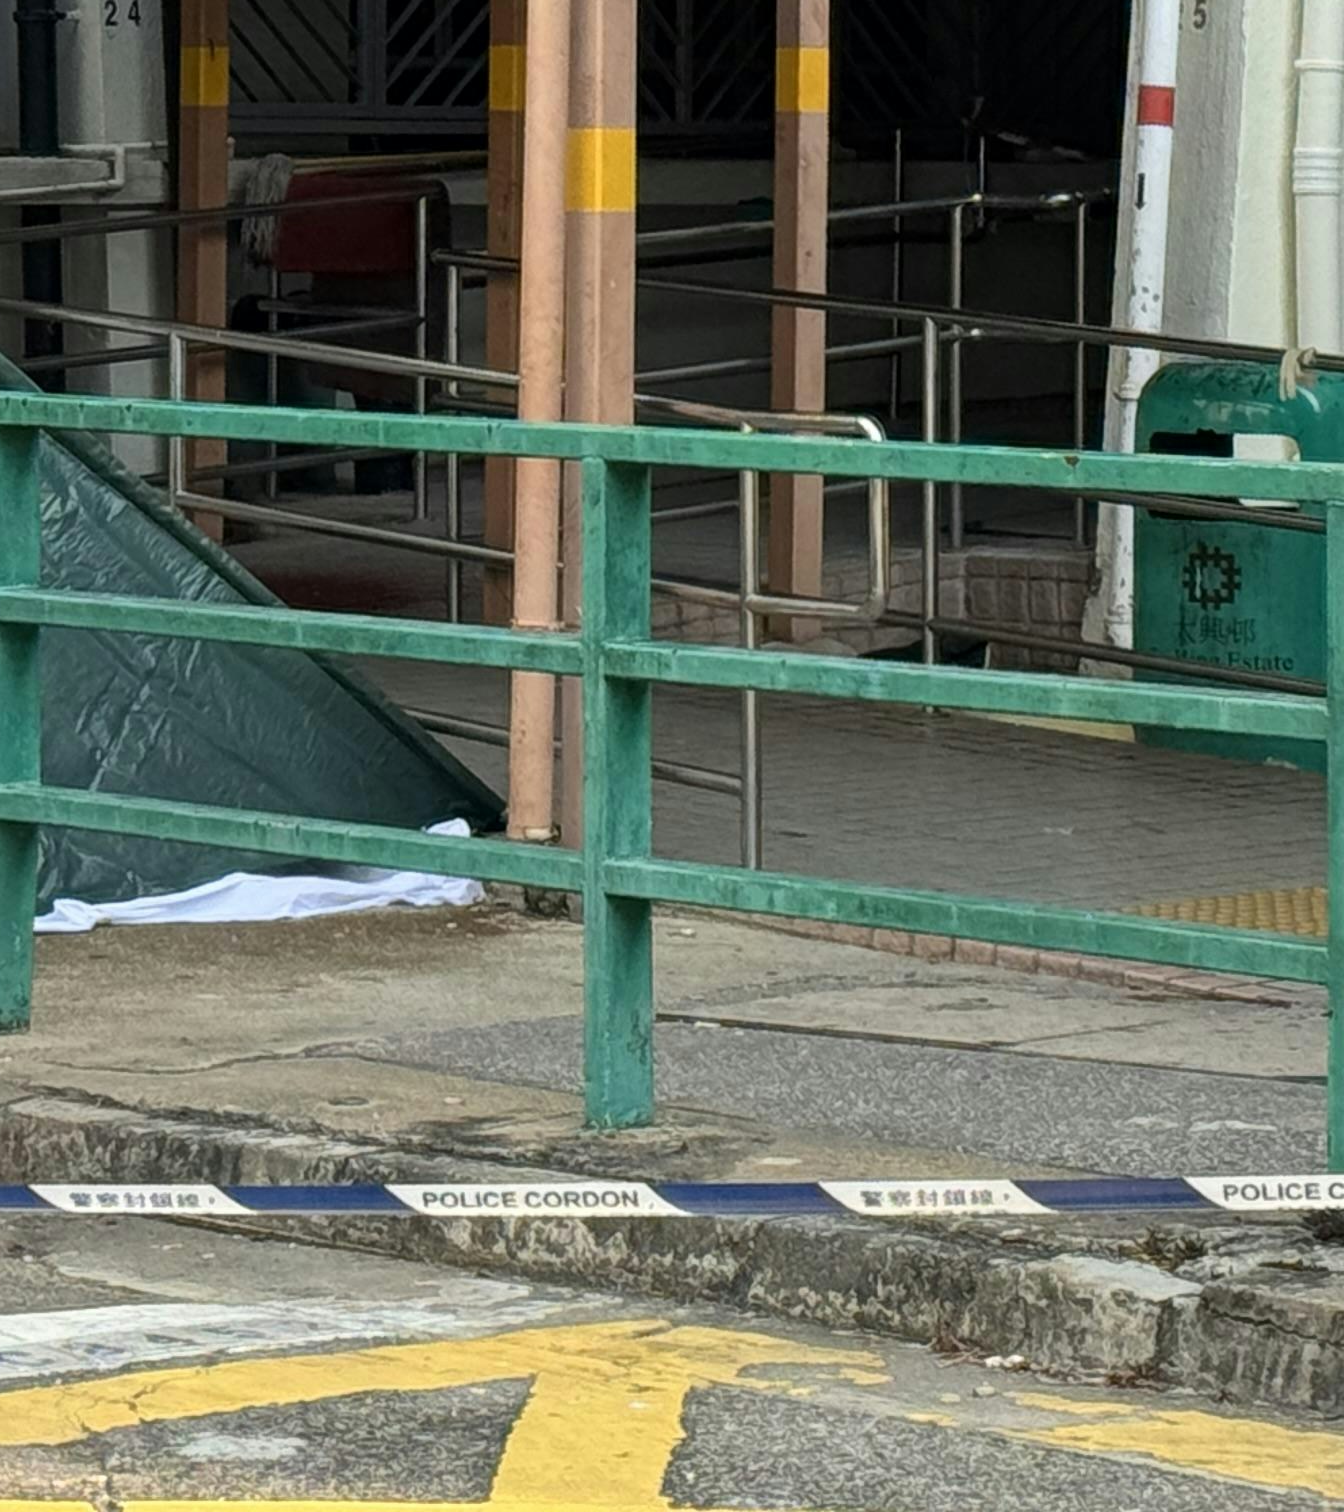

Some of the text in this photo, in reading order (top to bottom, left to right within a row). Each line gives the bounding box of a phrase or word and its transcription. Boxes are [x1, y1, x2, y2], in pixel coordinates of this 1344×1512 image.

[422, 1190, 639, 1208] POLICE CORDON
[1222, 1182, 1321, 1202] POLICE
